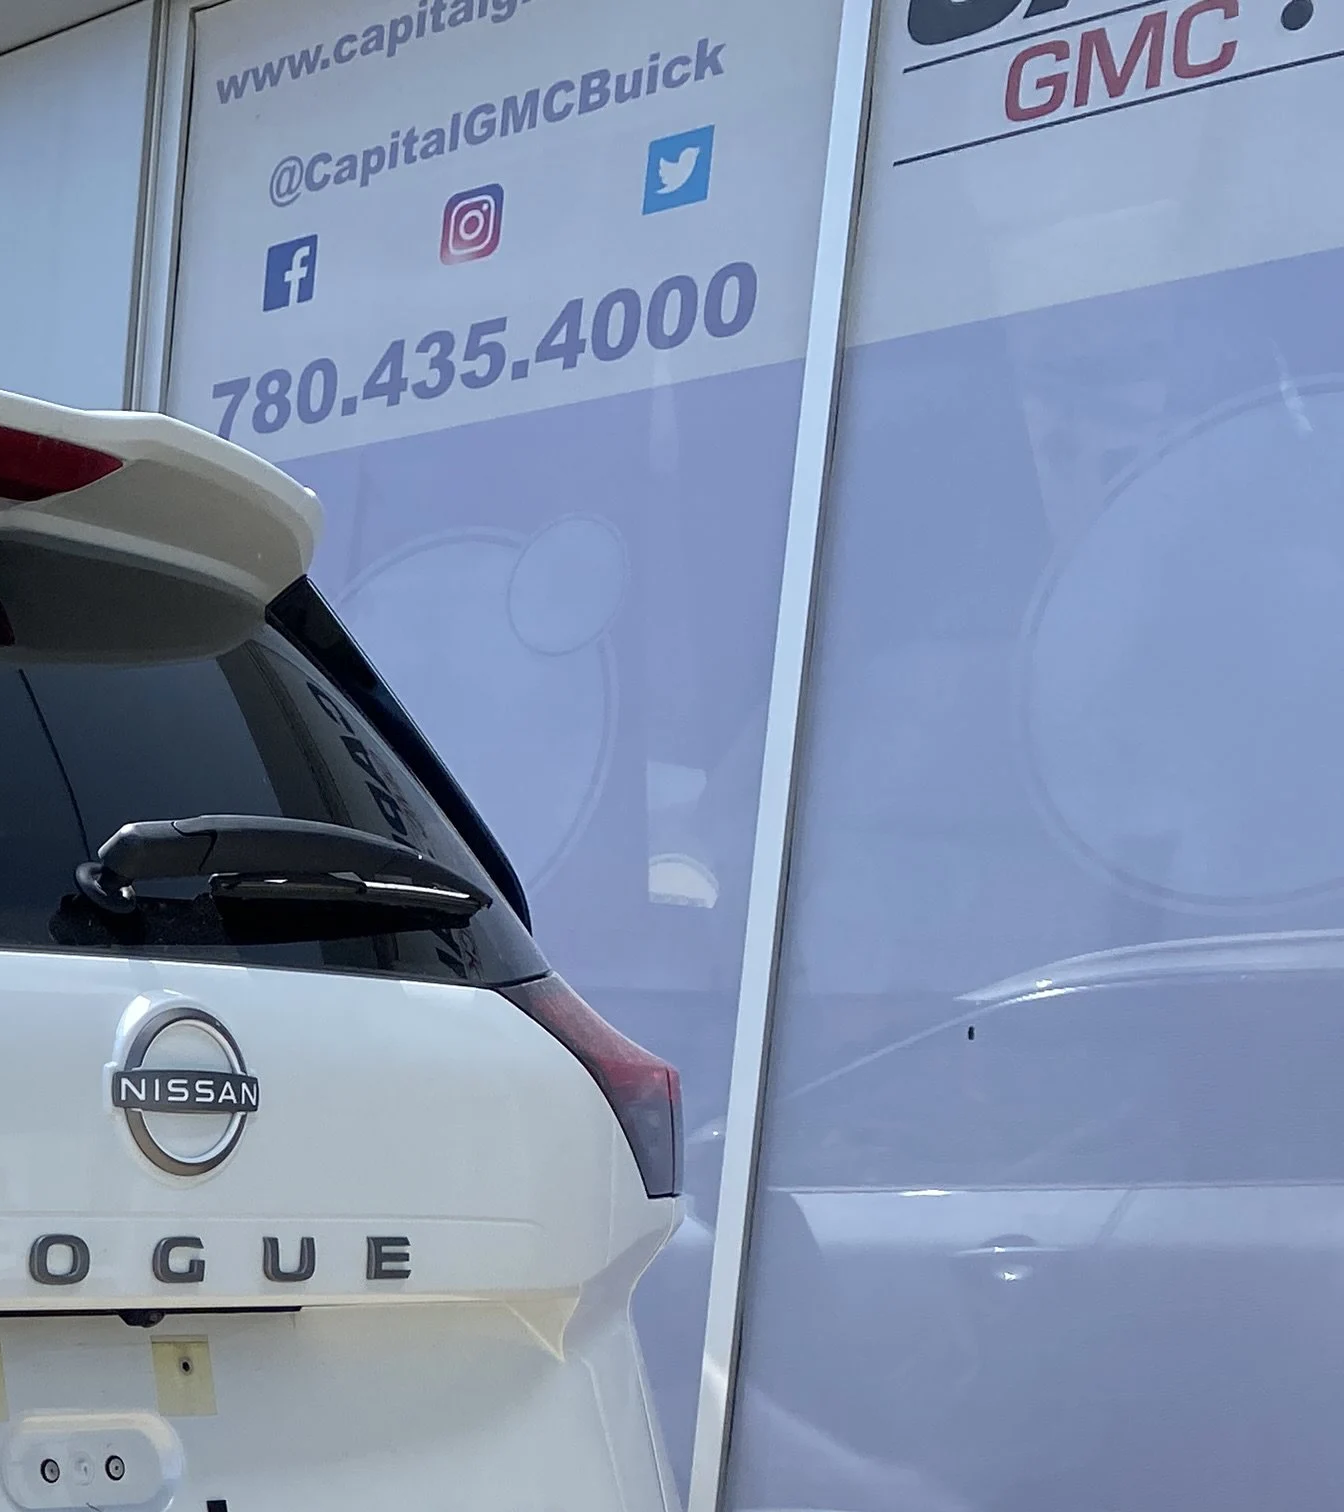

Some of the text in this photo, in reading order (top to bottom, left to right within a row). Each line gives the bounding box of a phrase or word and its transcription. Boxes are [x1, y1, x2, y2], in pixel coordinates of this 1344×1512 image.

[268, 37, 730, 208] @CapitalGMCBuick
[1005, 0, 1240, 122] GMC
[211, 261, 759, 440] 780.435.4000
[120, 1077, 258, 1106] NISSAN
